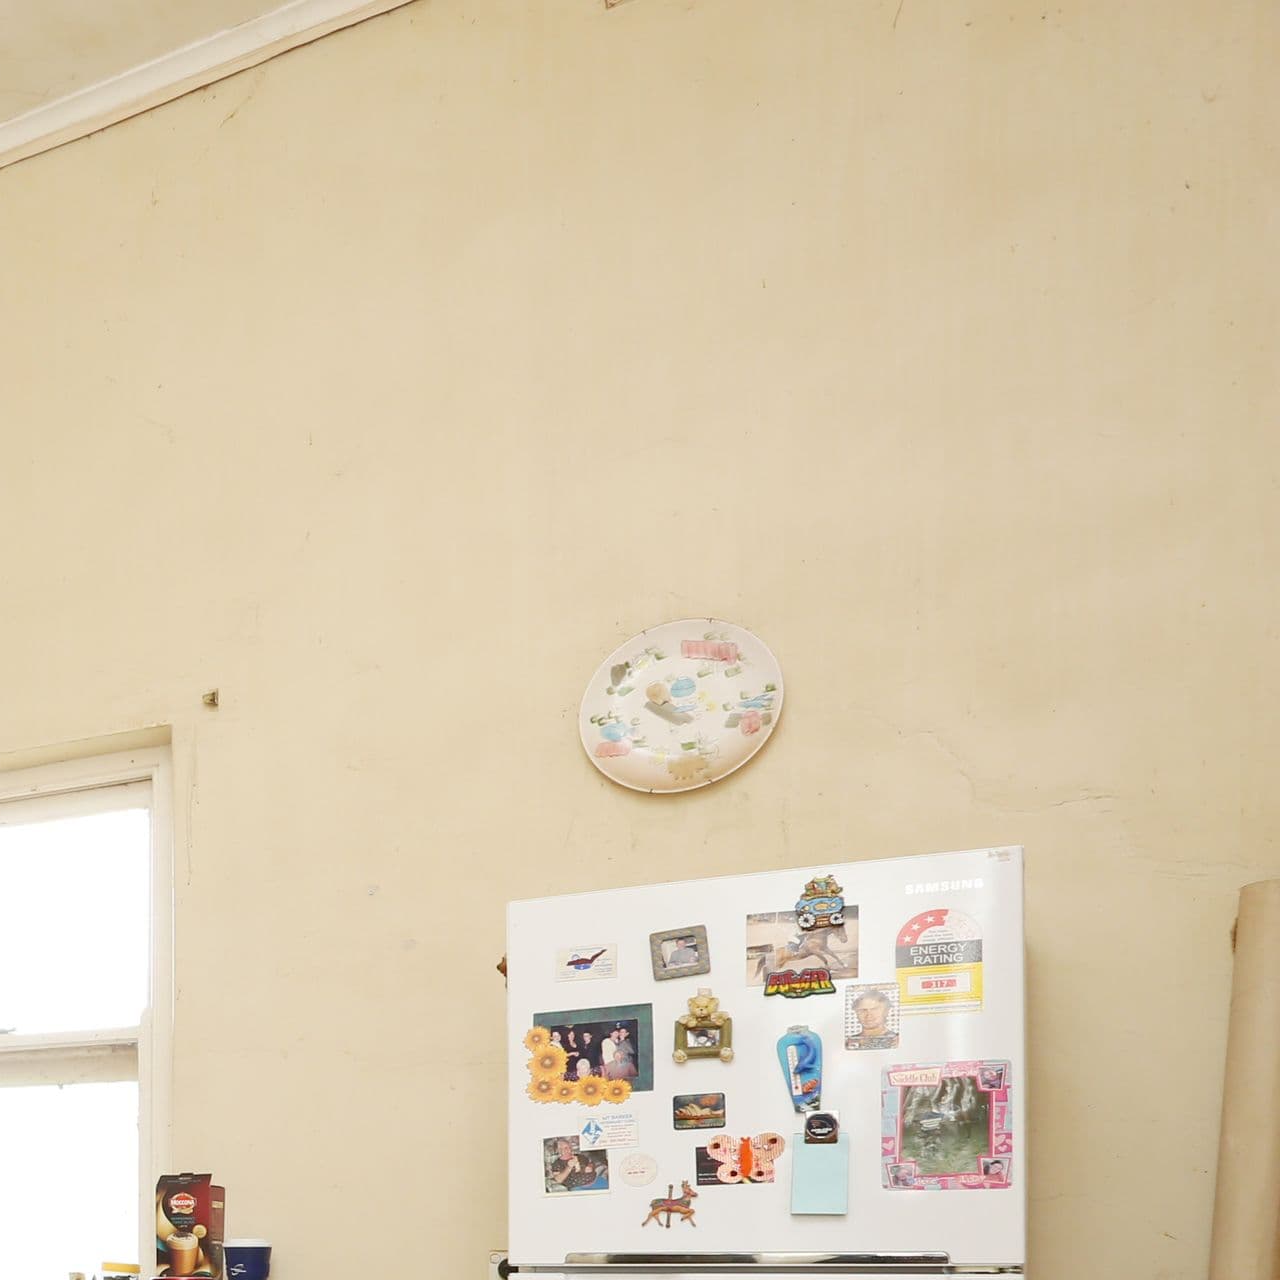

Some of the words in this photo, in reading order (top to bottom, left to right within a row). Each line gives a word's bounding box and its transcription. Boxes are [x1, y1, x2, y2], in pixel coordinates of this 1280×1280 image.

[905, 878, 984, 895] SAMSUNG
[910, 942, 968, 956] ENERGY
[913, 952, 965, 966] RATING
